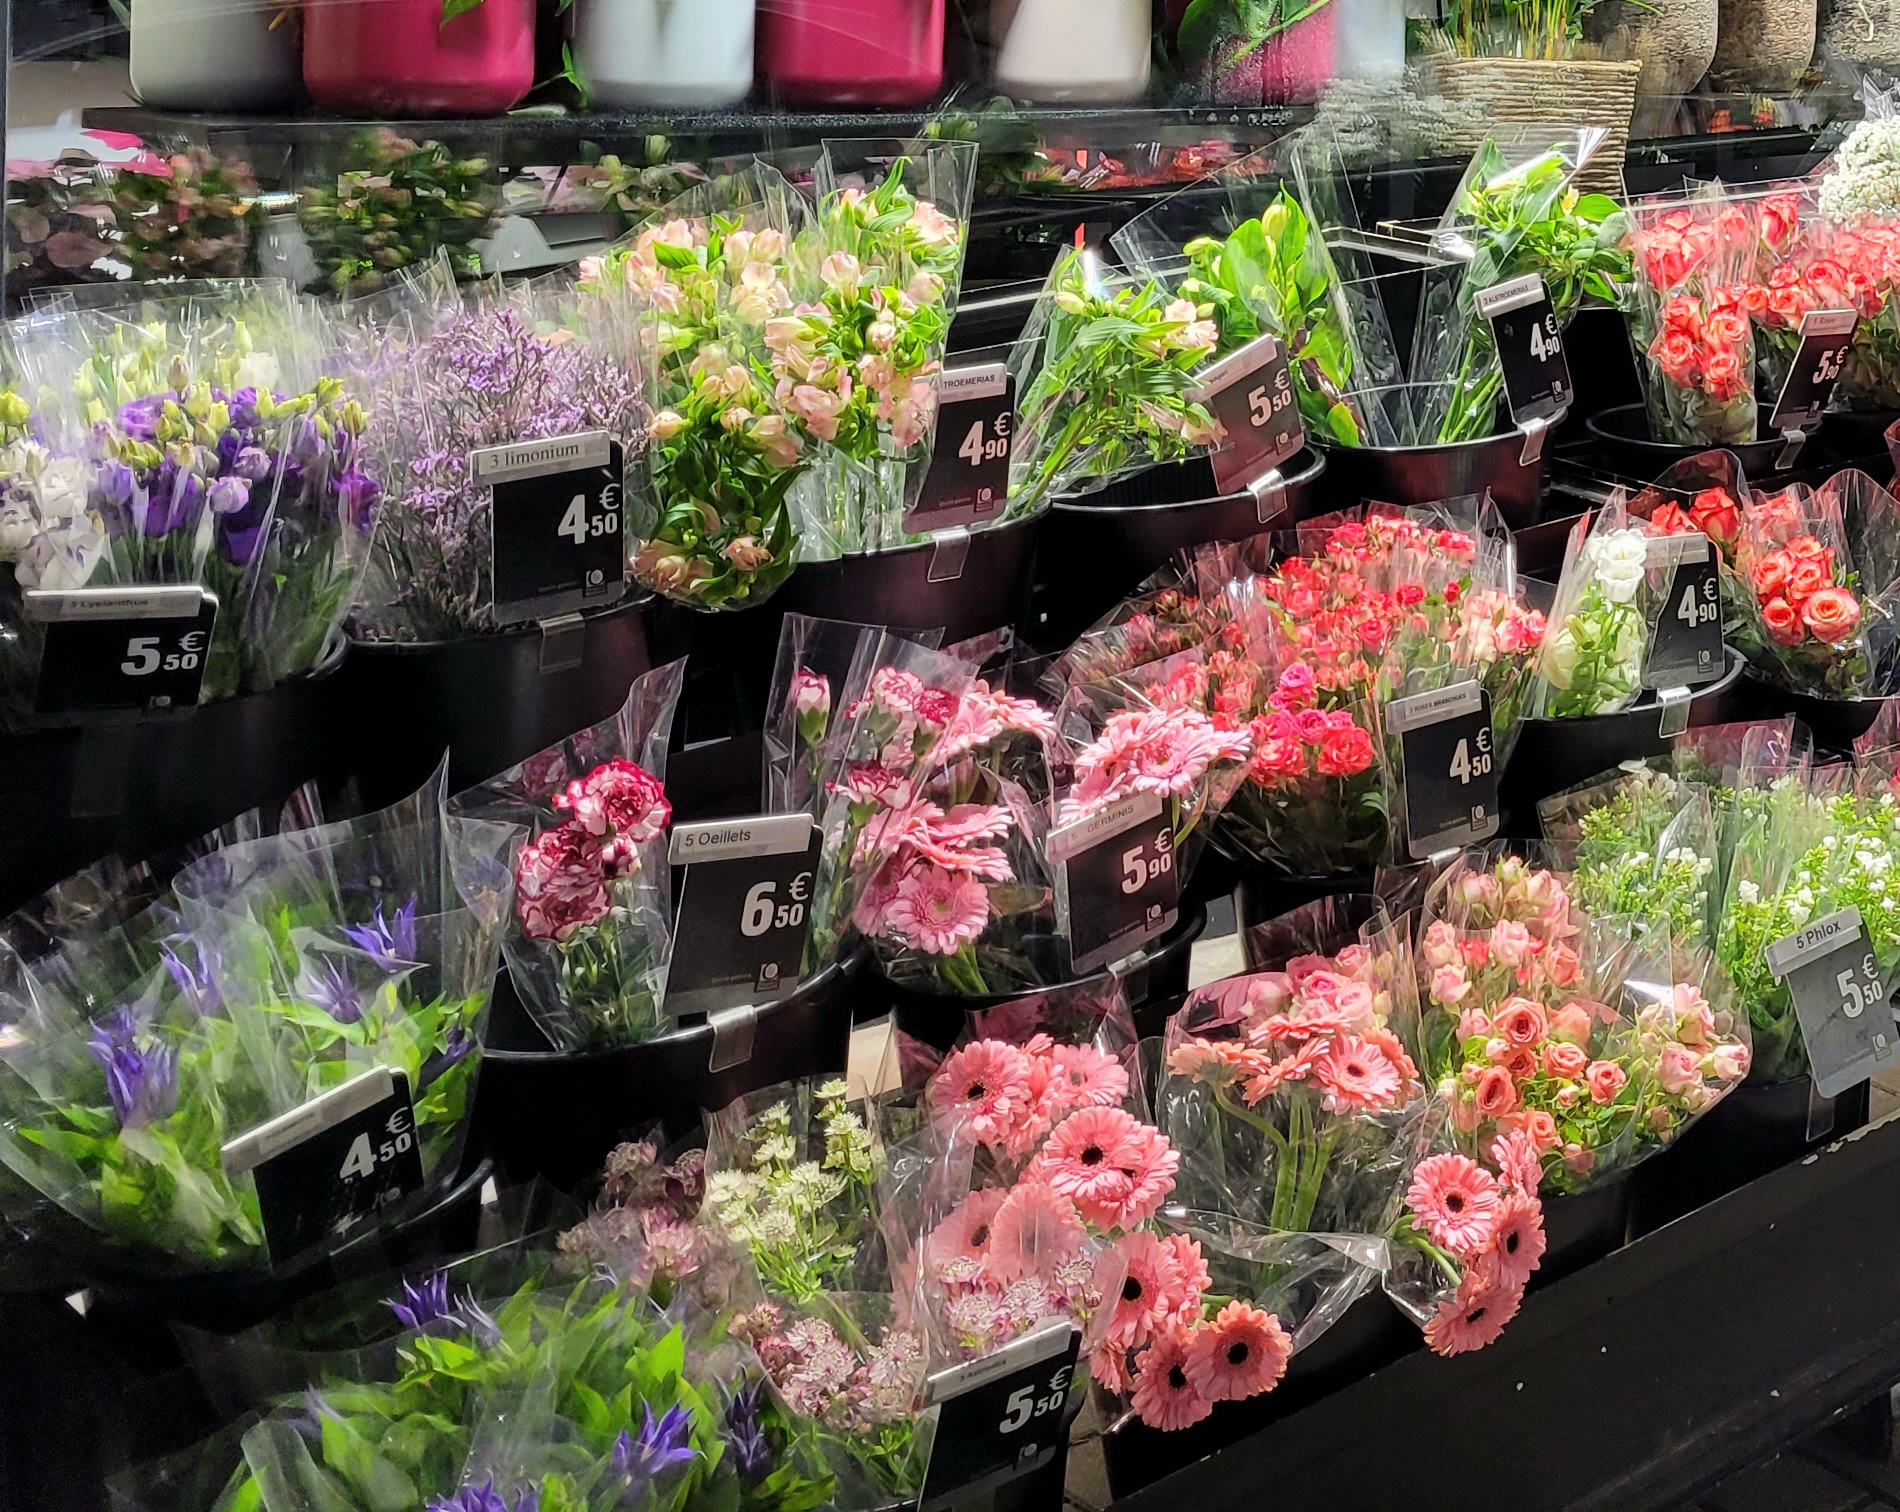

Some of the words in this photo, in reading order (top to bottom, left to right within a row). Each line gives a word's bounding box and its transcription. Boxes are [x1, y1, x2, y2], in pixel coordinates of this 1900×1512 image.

[943, 374, 996, 389] TROEMERIAS
[490, 454, 499, 469] 3
[505, 443, 580, 467] limonium
[1087, 804, 1135, 834] GERMINIS
[684, 833, 694, 847] 5
[698, 829, 752, 846] Oeillets
[1796, 935, 1805, 950] 5
[1805, 920, 1842, 945] Phlox
